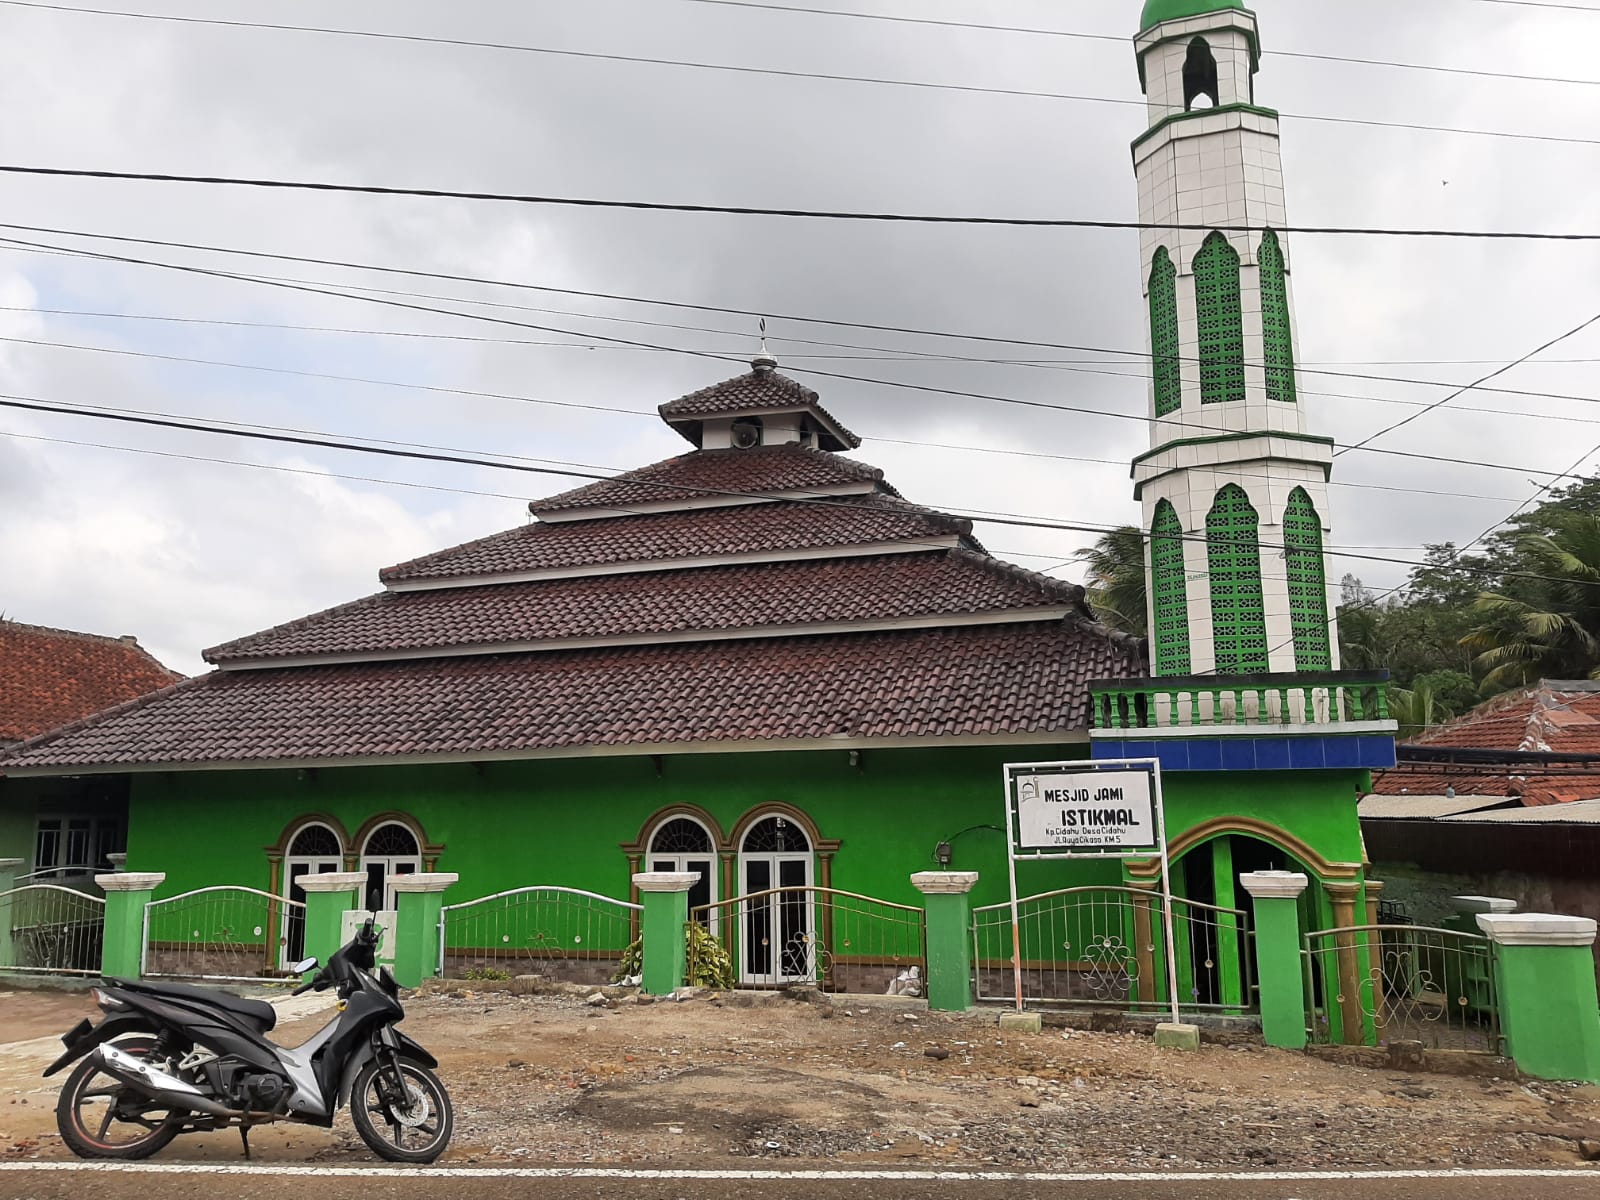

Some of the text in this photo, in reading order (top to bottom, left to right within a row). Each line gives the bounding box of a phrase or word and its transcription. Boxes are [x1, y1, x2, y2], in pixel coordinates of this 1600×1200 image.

[1044, 787, 1123, 803] MESJID JAMI
[1061, 808, 1140, 826] ISTIKMAL
